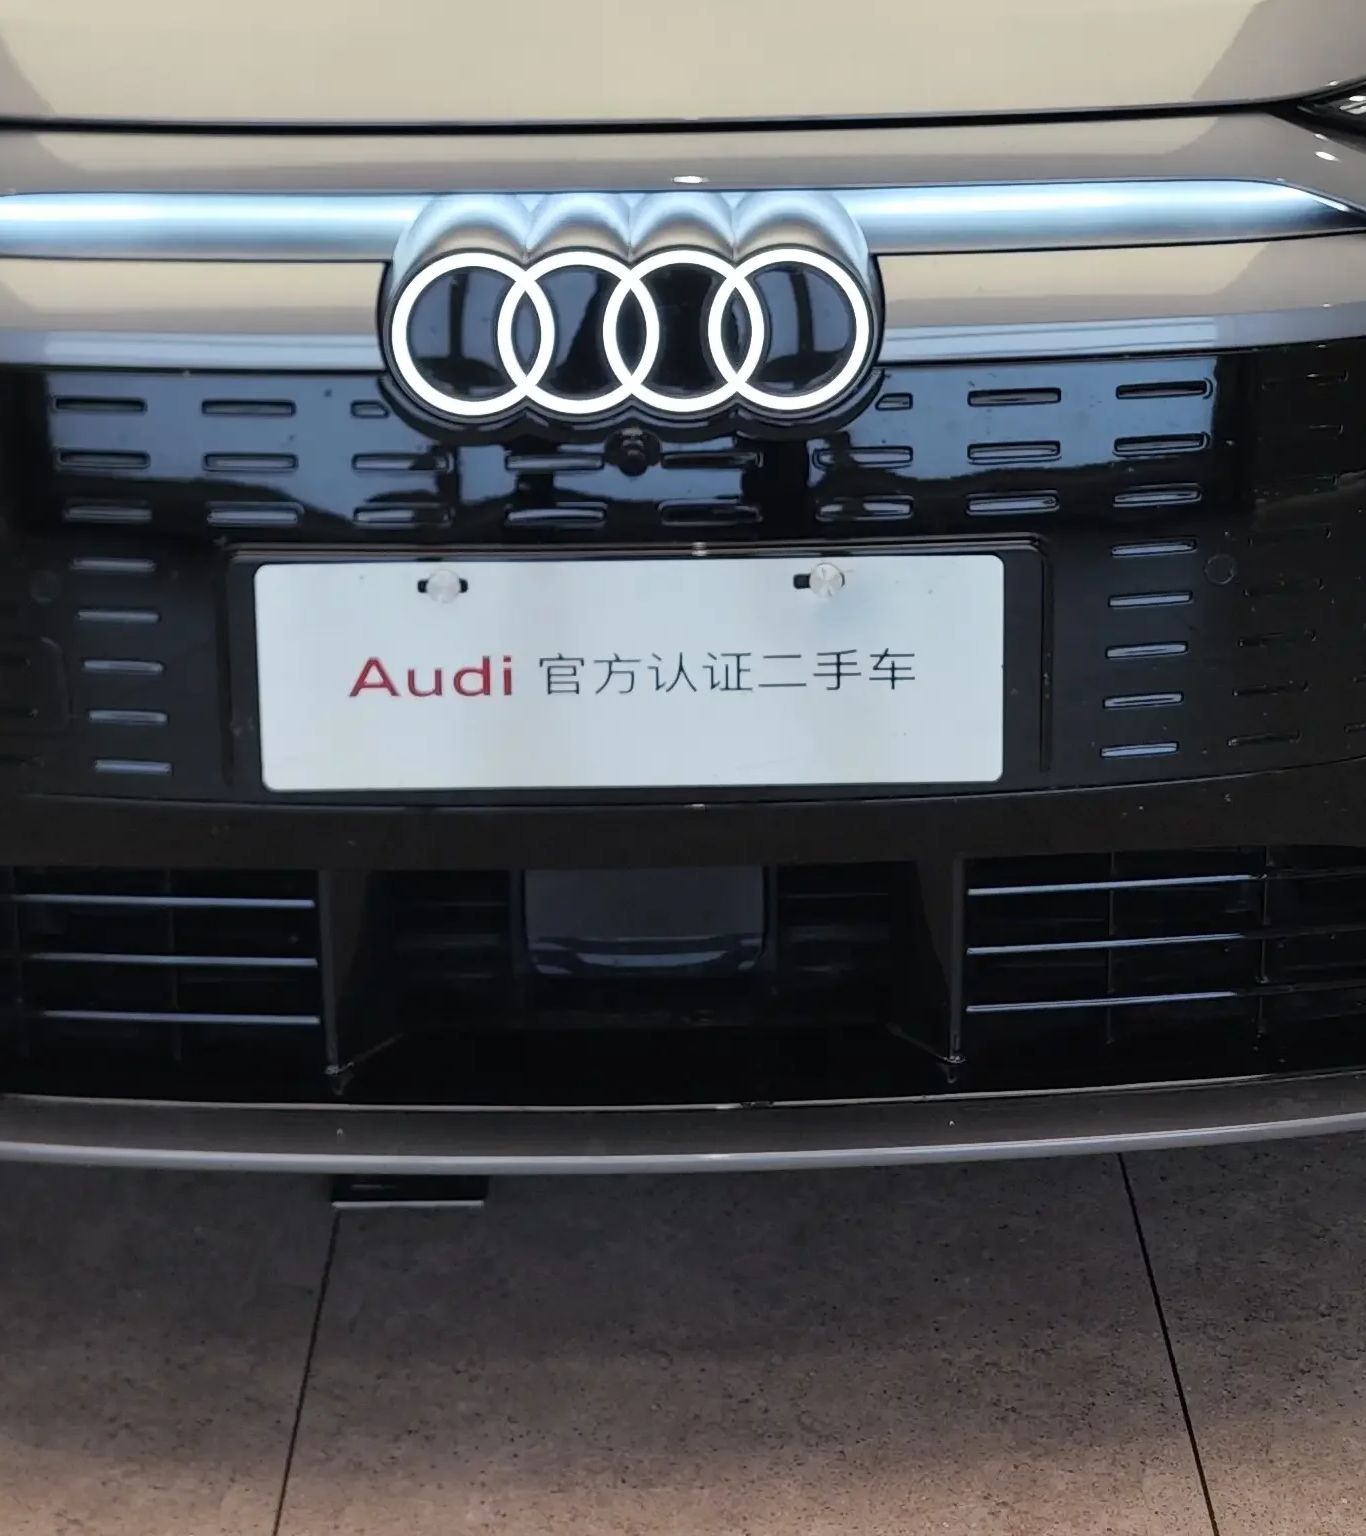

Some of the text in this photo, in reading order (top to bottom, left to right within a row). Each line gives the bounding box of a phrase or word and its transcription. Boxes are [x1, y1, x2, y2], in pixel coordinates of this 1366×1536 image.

[349, 648, 916, 698] Audi 官方认证二手车
